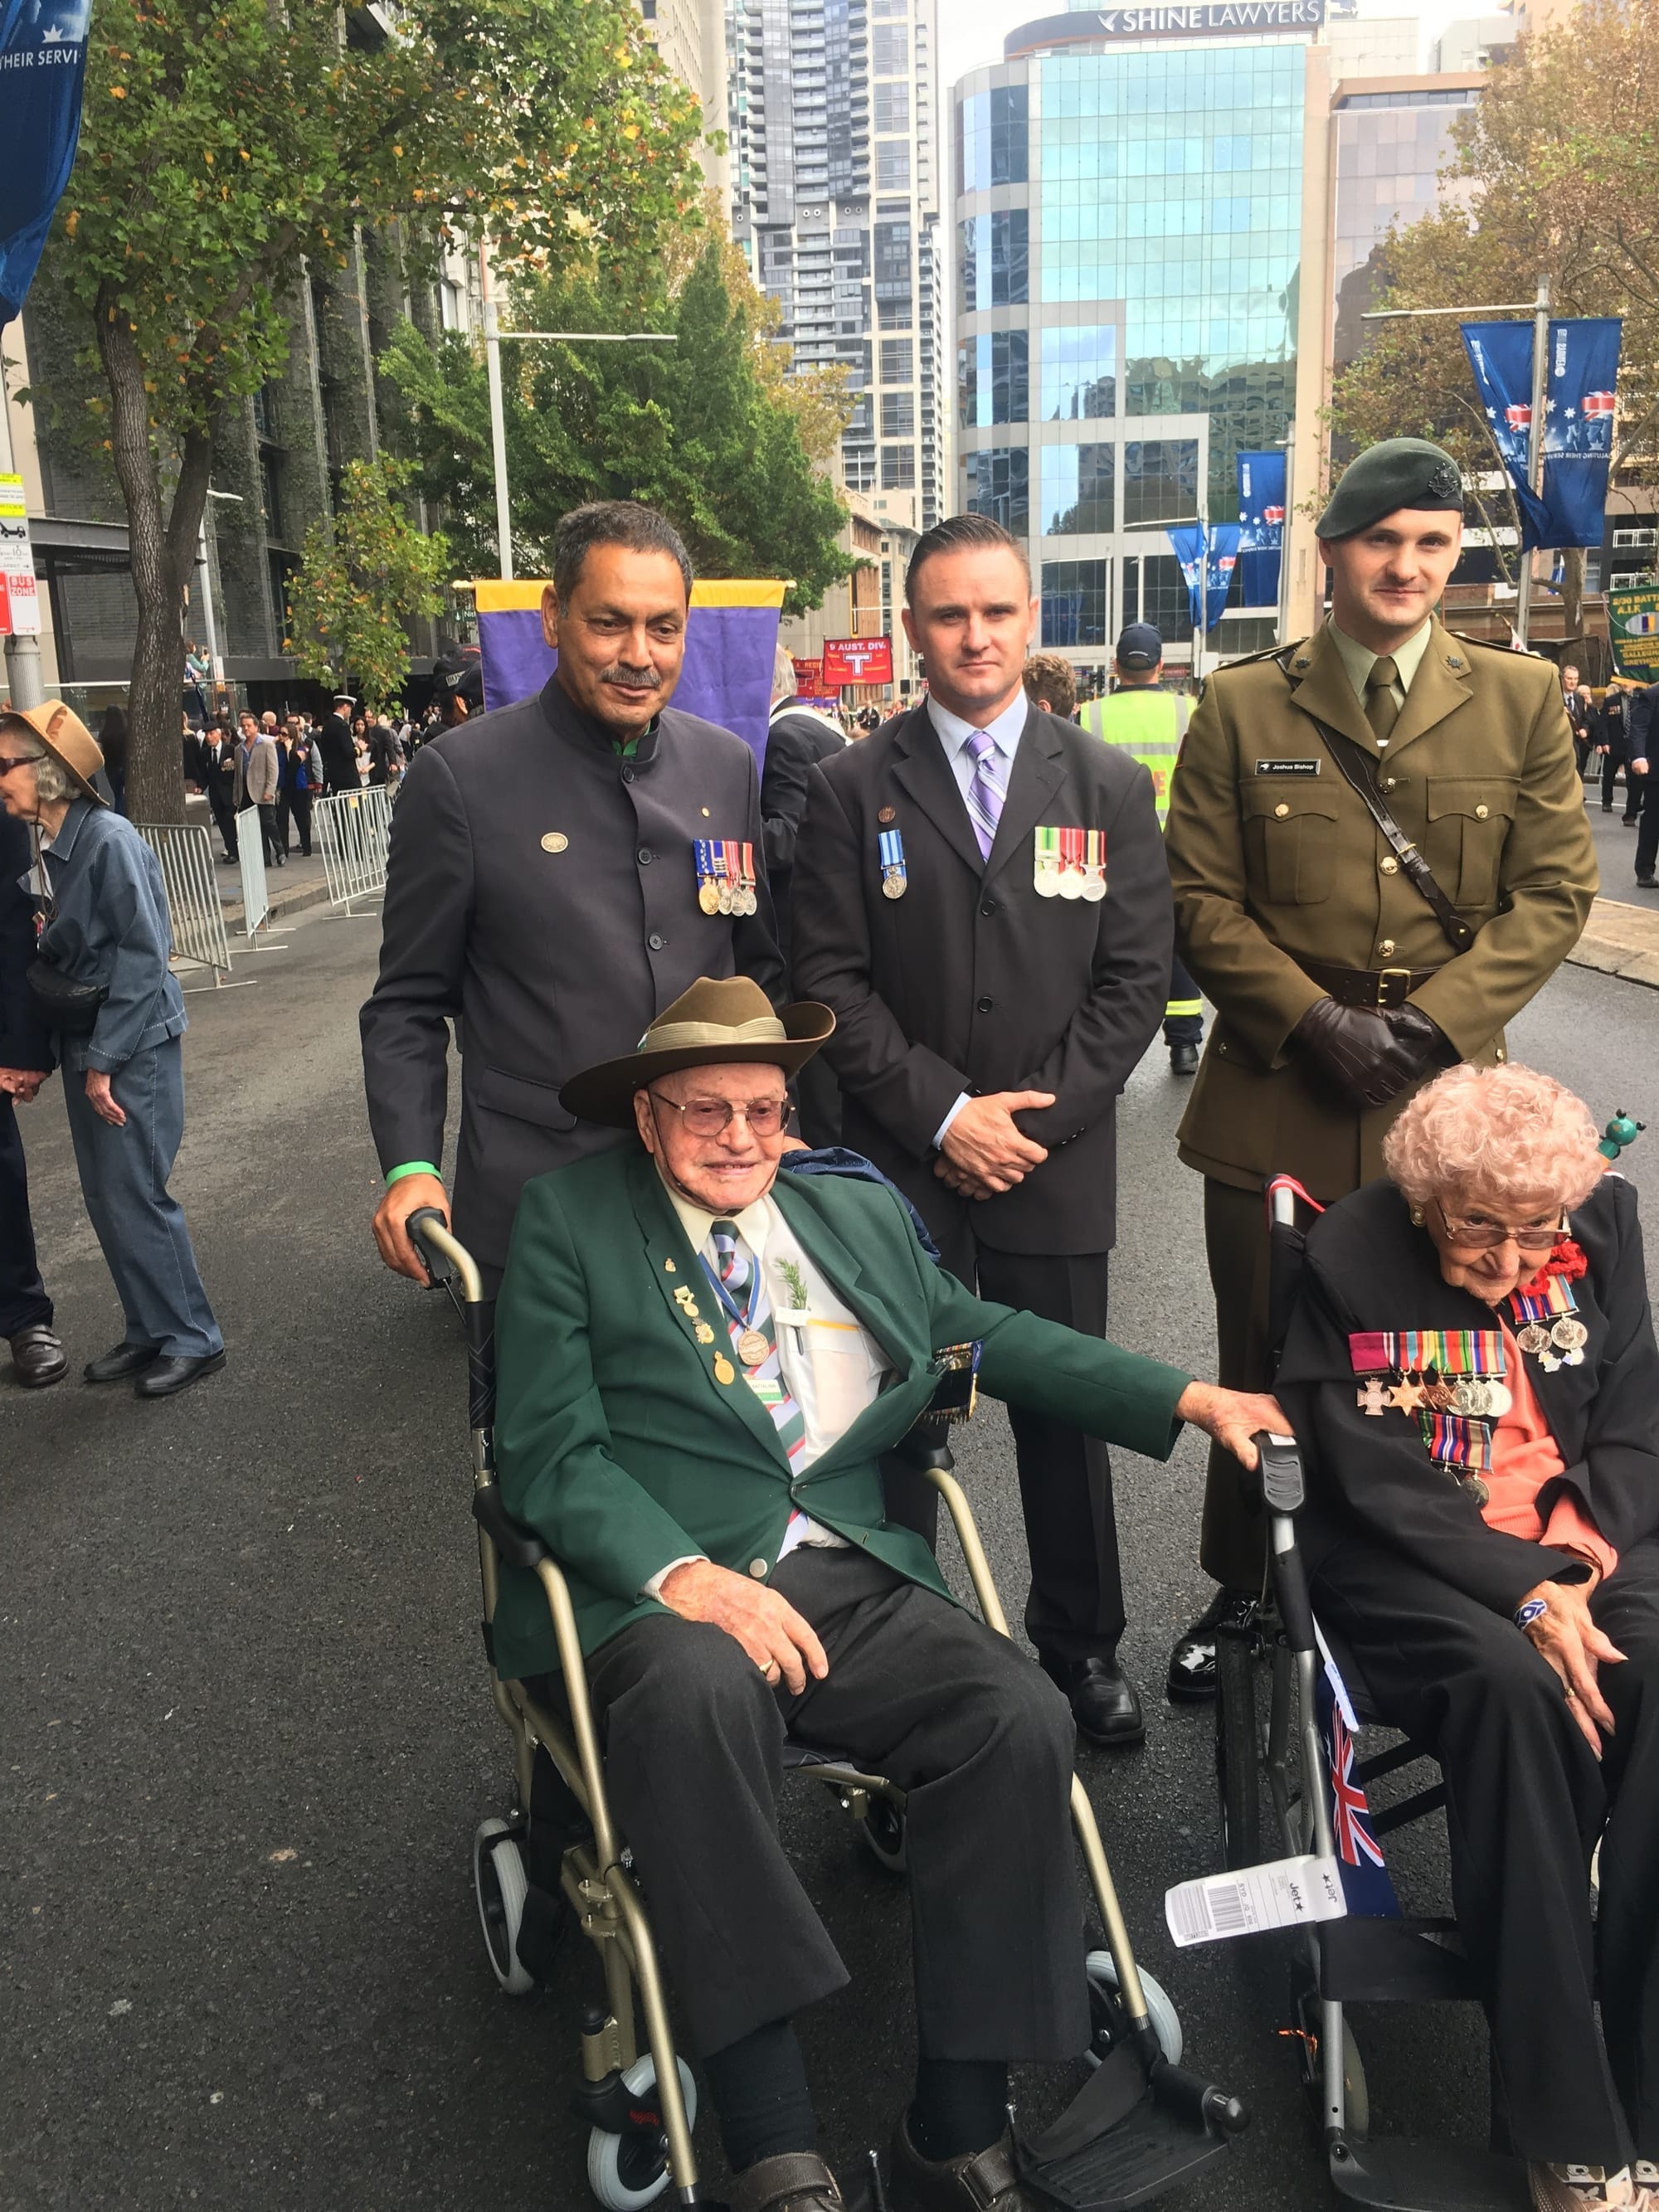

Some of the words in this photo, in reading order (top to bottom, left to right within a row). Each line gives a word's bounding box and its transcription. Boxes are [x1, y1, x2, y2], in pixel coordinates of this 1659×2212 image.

[1122, 7, 1202, 32] SHINE
[1209, 1, 1320, 27] LAWYERS
[37, 48, 81, 66] SERVI
[11, 576, 32, 586] BUS
[11, 586, 35, 596] ZONE
[830, 643, 835, 651] 9
[838, 642, 865, 651] AUST.
[868, 641, 886, 650] DIV.
[1239, 1883, 1248, 1898] SYD
[1289, 1882, 1302, 1903] Jet
[1325, 1884, 1337, 1903] Jet
